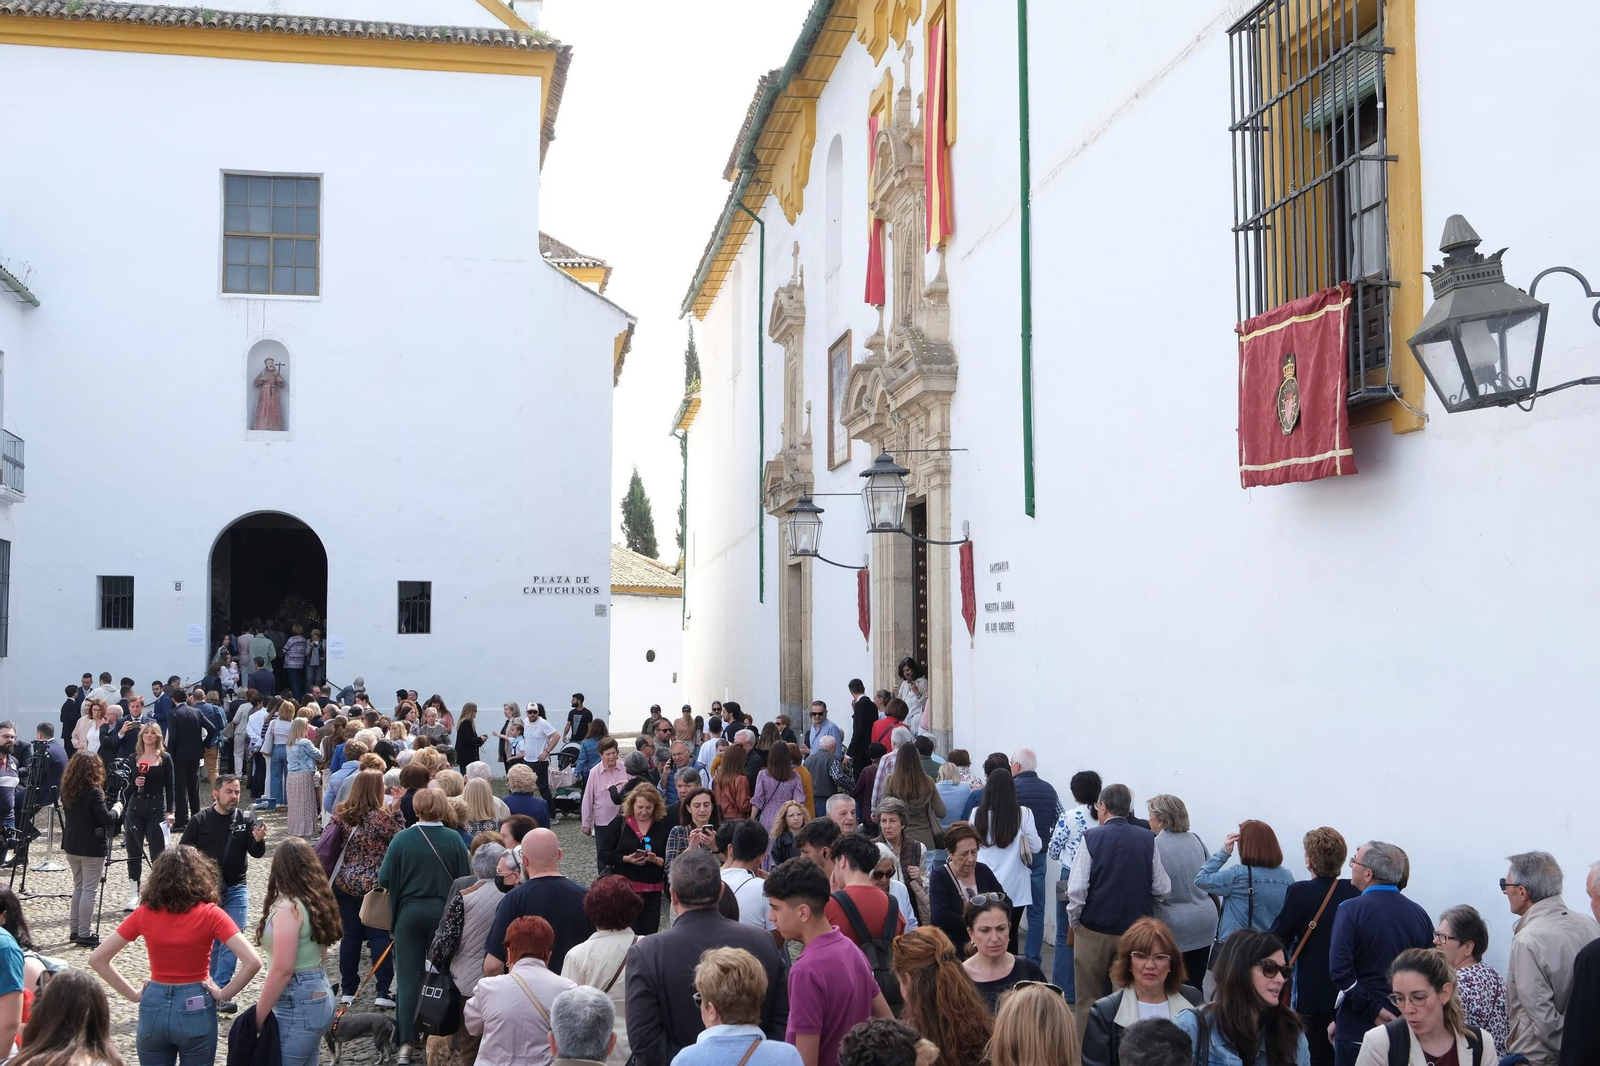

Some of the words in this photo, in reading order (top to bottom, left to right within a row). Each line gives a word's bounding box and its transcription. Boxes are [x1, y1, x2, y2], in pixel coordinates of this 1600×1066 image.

[533, 575, 571, 584] PLAZA
[575, 576, 590, 584] DE
[523, 586, 600, 594] CAPUCHINOS
[996, 582, 1001, 591] DE
[985, 622, 990, 631] DE
[999, 622, 1014, 631] DOLORES
